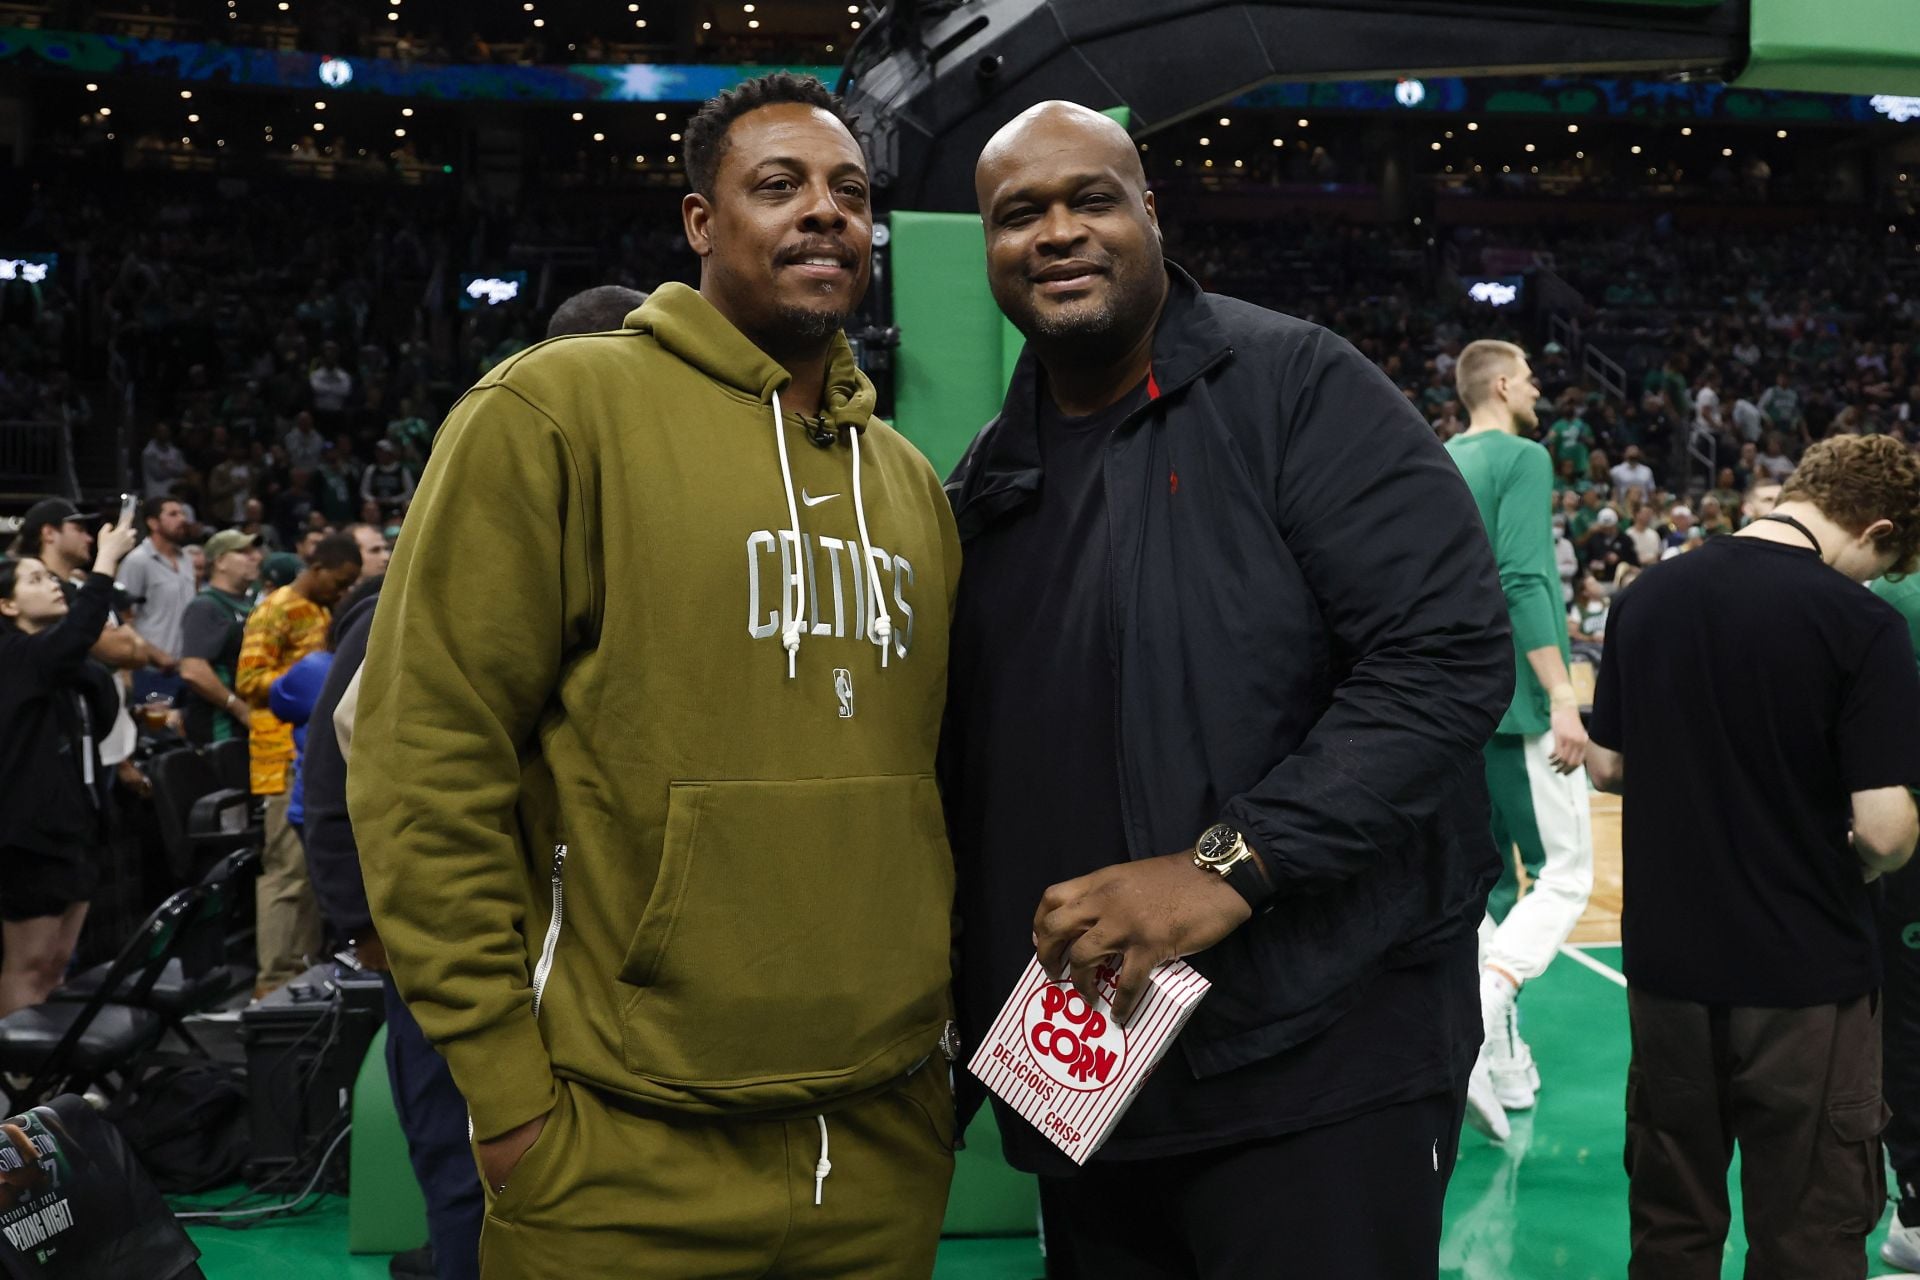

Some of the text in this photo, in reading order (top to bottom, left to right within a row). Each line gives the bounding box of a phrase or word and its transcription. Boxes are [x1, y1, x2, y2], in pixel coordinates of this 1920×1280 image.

[1041, 985, 1107, 1042] POP
[992, 1043, 1054, 1101] DELICIOUS
[1031, 1021, 1119, 1084] CORN
[1044, 1111, 1081, 1144] CRISP
[2, 1198, 74, 1252] PENING NIGHT
